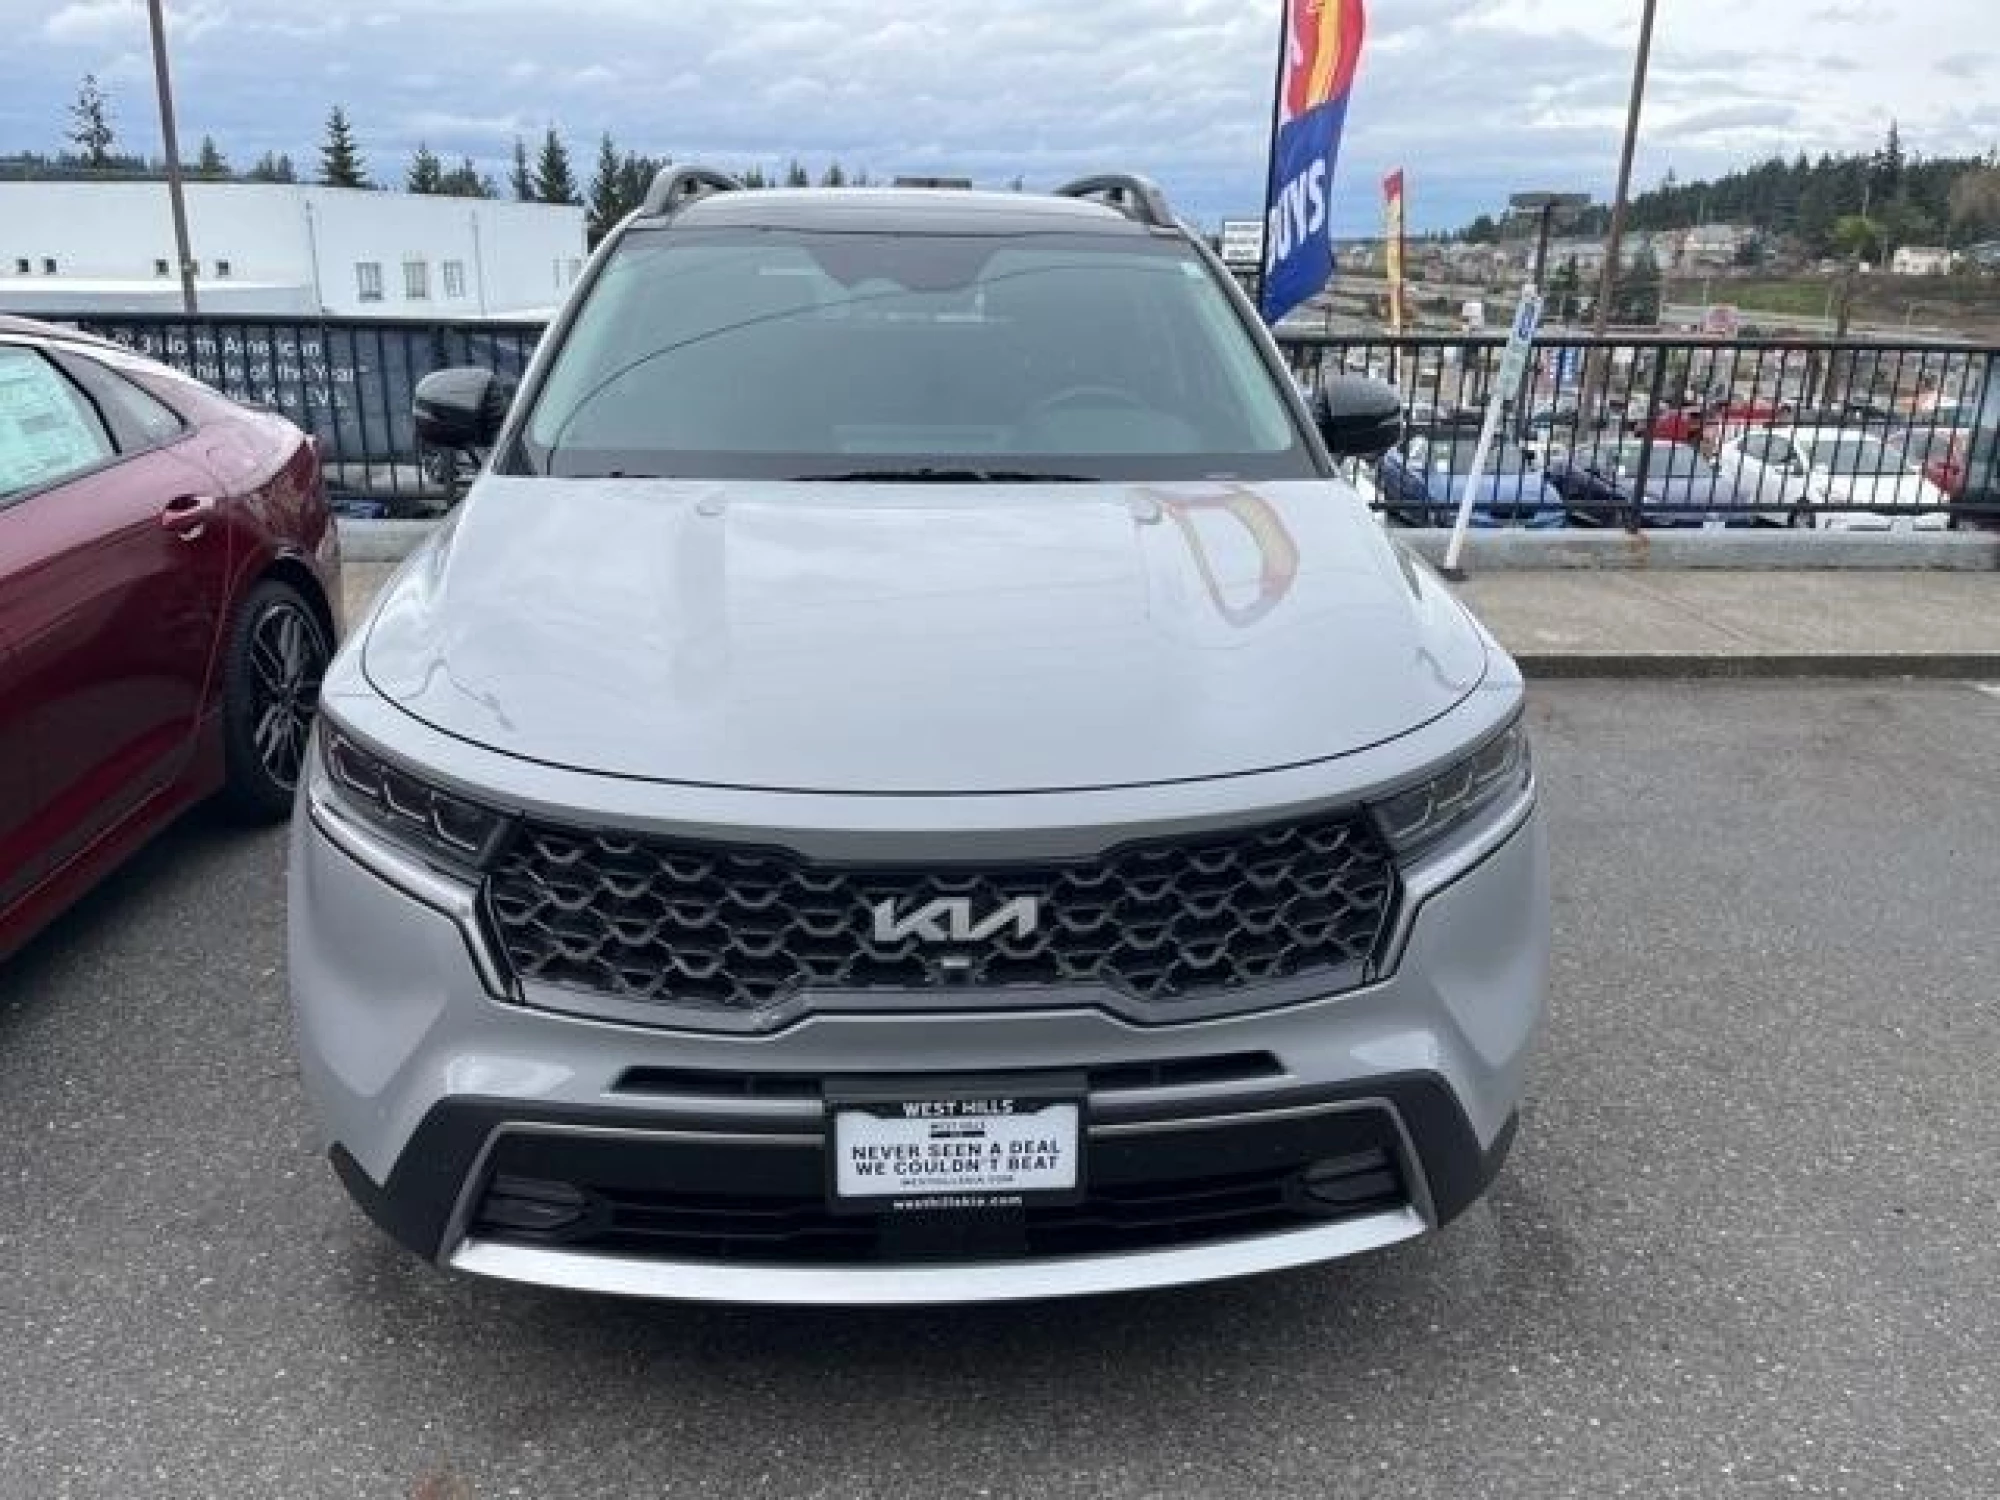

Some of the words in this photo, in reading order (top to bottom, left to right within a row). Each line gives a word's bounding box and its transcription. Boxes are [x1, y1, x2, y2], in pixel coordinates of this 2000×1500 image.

[312, 364, 355, 382] Yar
[875, 897, 1037, 941] KIA
[903, 1102, 957, 1117] WEST
[962, 1099, 1014, 1114] HILLS
[852, 1143, 920, 1160] NEVER
[927, 1143, 982, 1158] SEEN
[990, 1142, 1002, 1157] A
[1009, 1138, 1061, 1154] DEAL
[855, 1161, 887, 1176] WE
[893, 1158, 999, 1176] COULDN'T
[1008, 1155, 1058, 1170] BEAT
